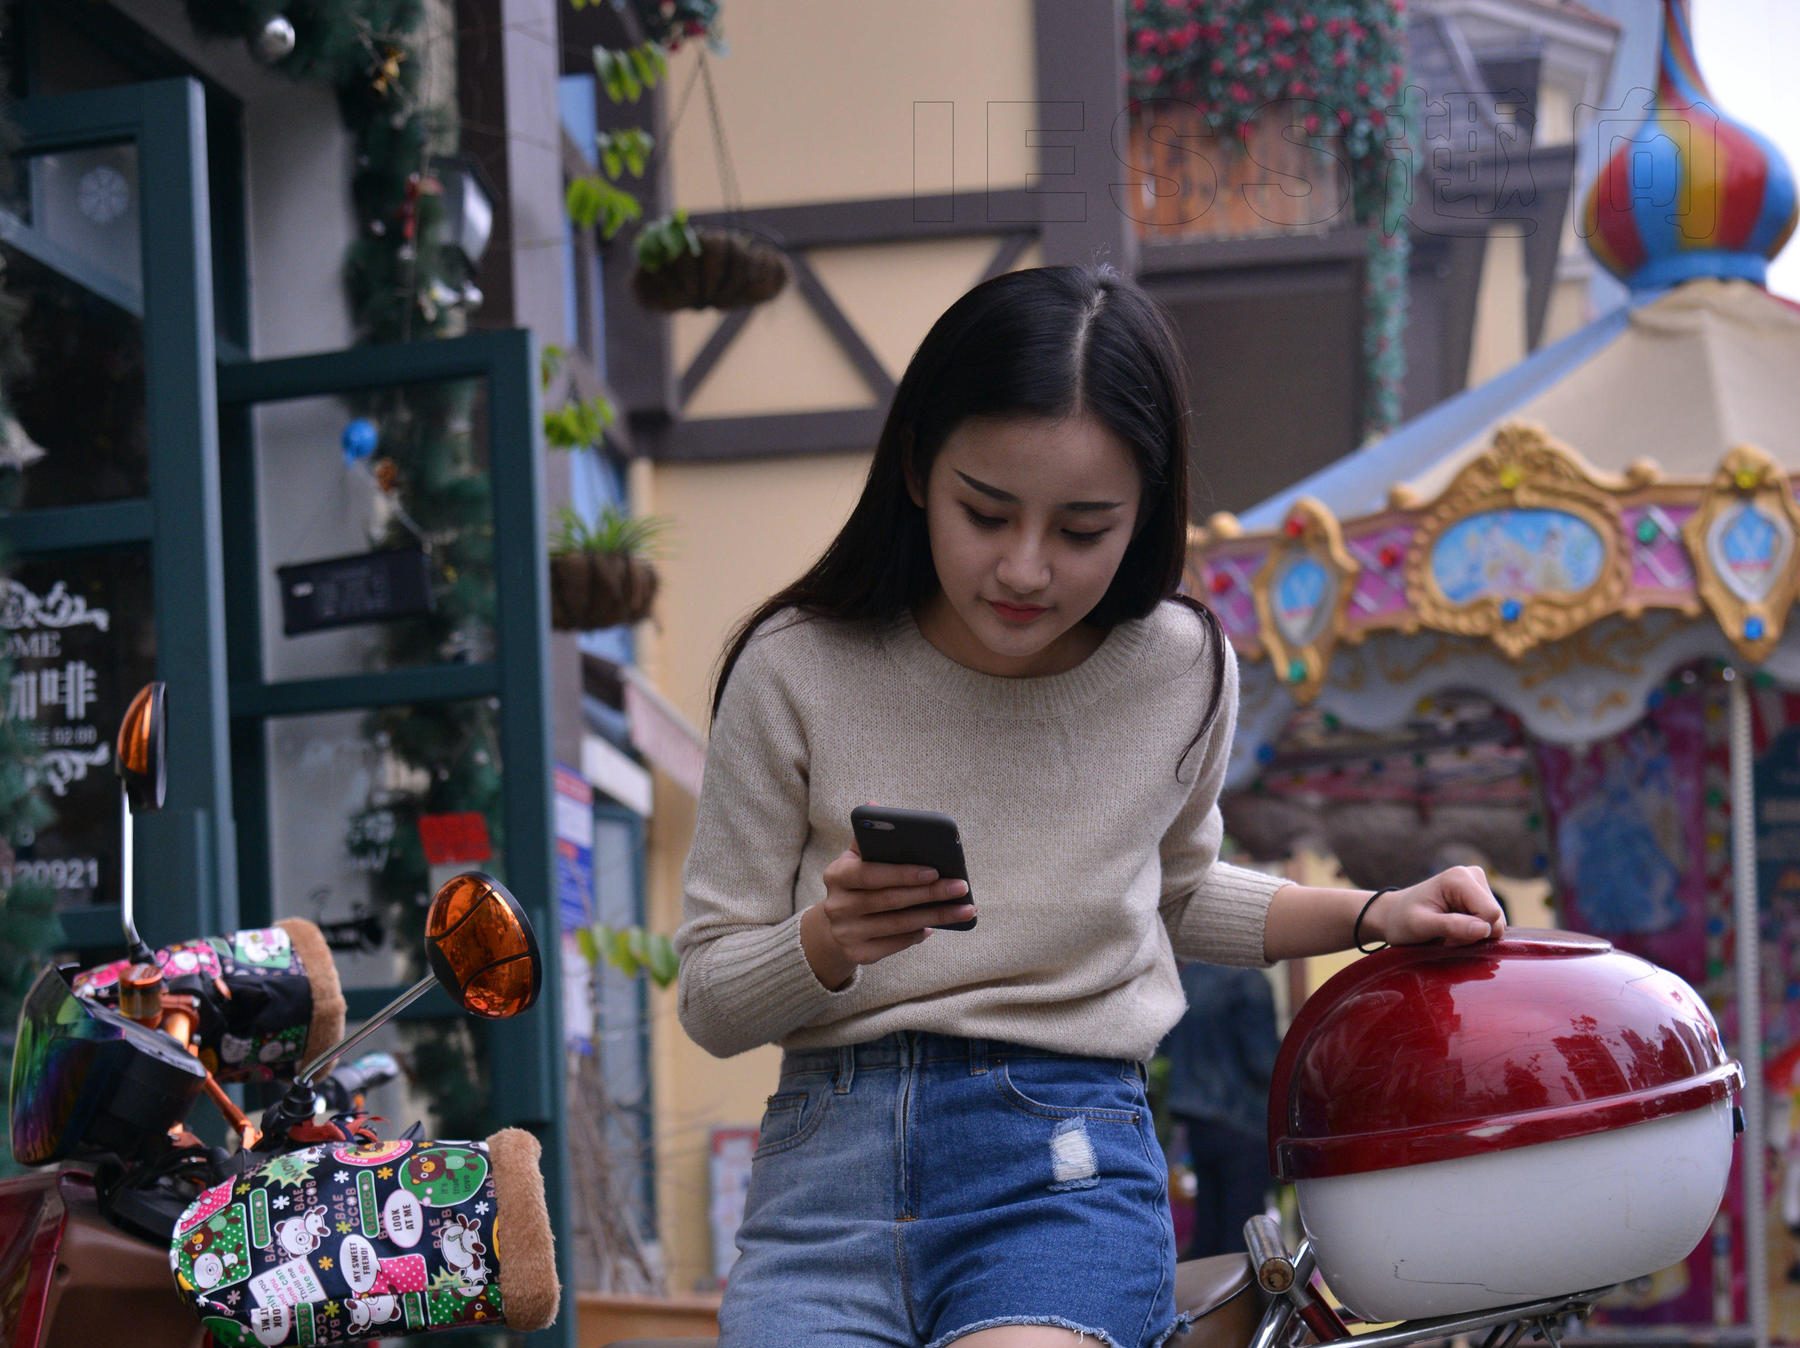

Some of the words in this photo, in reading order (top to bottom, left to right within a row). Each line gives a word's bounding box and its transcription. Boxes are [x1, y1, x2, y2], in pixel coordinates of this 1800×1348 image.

[292, 1188, 305, 1211] BAE
[332, 1194, 346, 1220] BAE
[402, 1203, 412, 1218] ME
[391, 1208, 402, 1232] LOOK
[405, 1219, 415, 1230] AT
[275, 1269, 289, 1286] can
[287, 1267, 297, 1279] me
[353, 1270, 361, 1283] MY
[258, 1279, 270, 1294] you
[303, 1275, 317, 1294] like
[261, 1318, 271, 1332] ME
[272, 1308, 282, 1328] OOK
